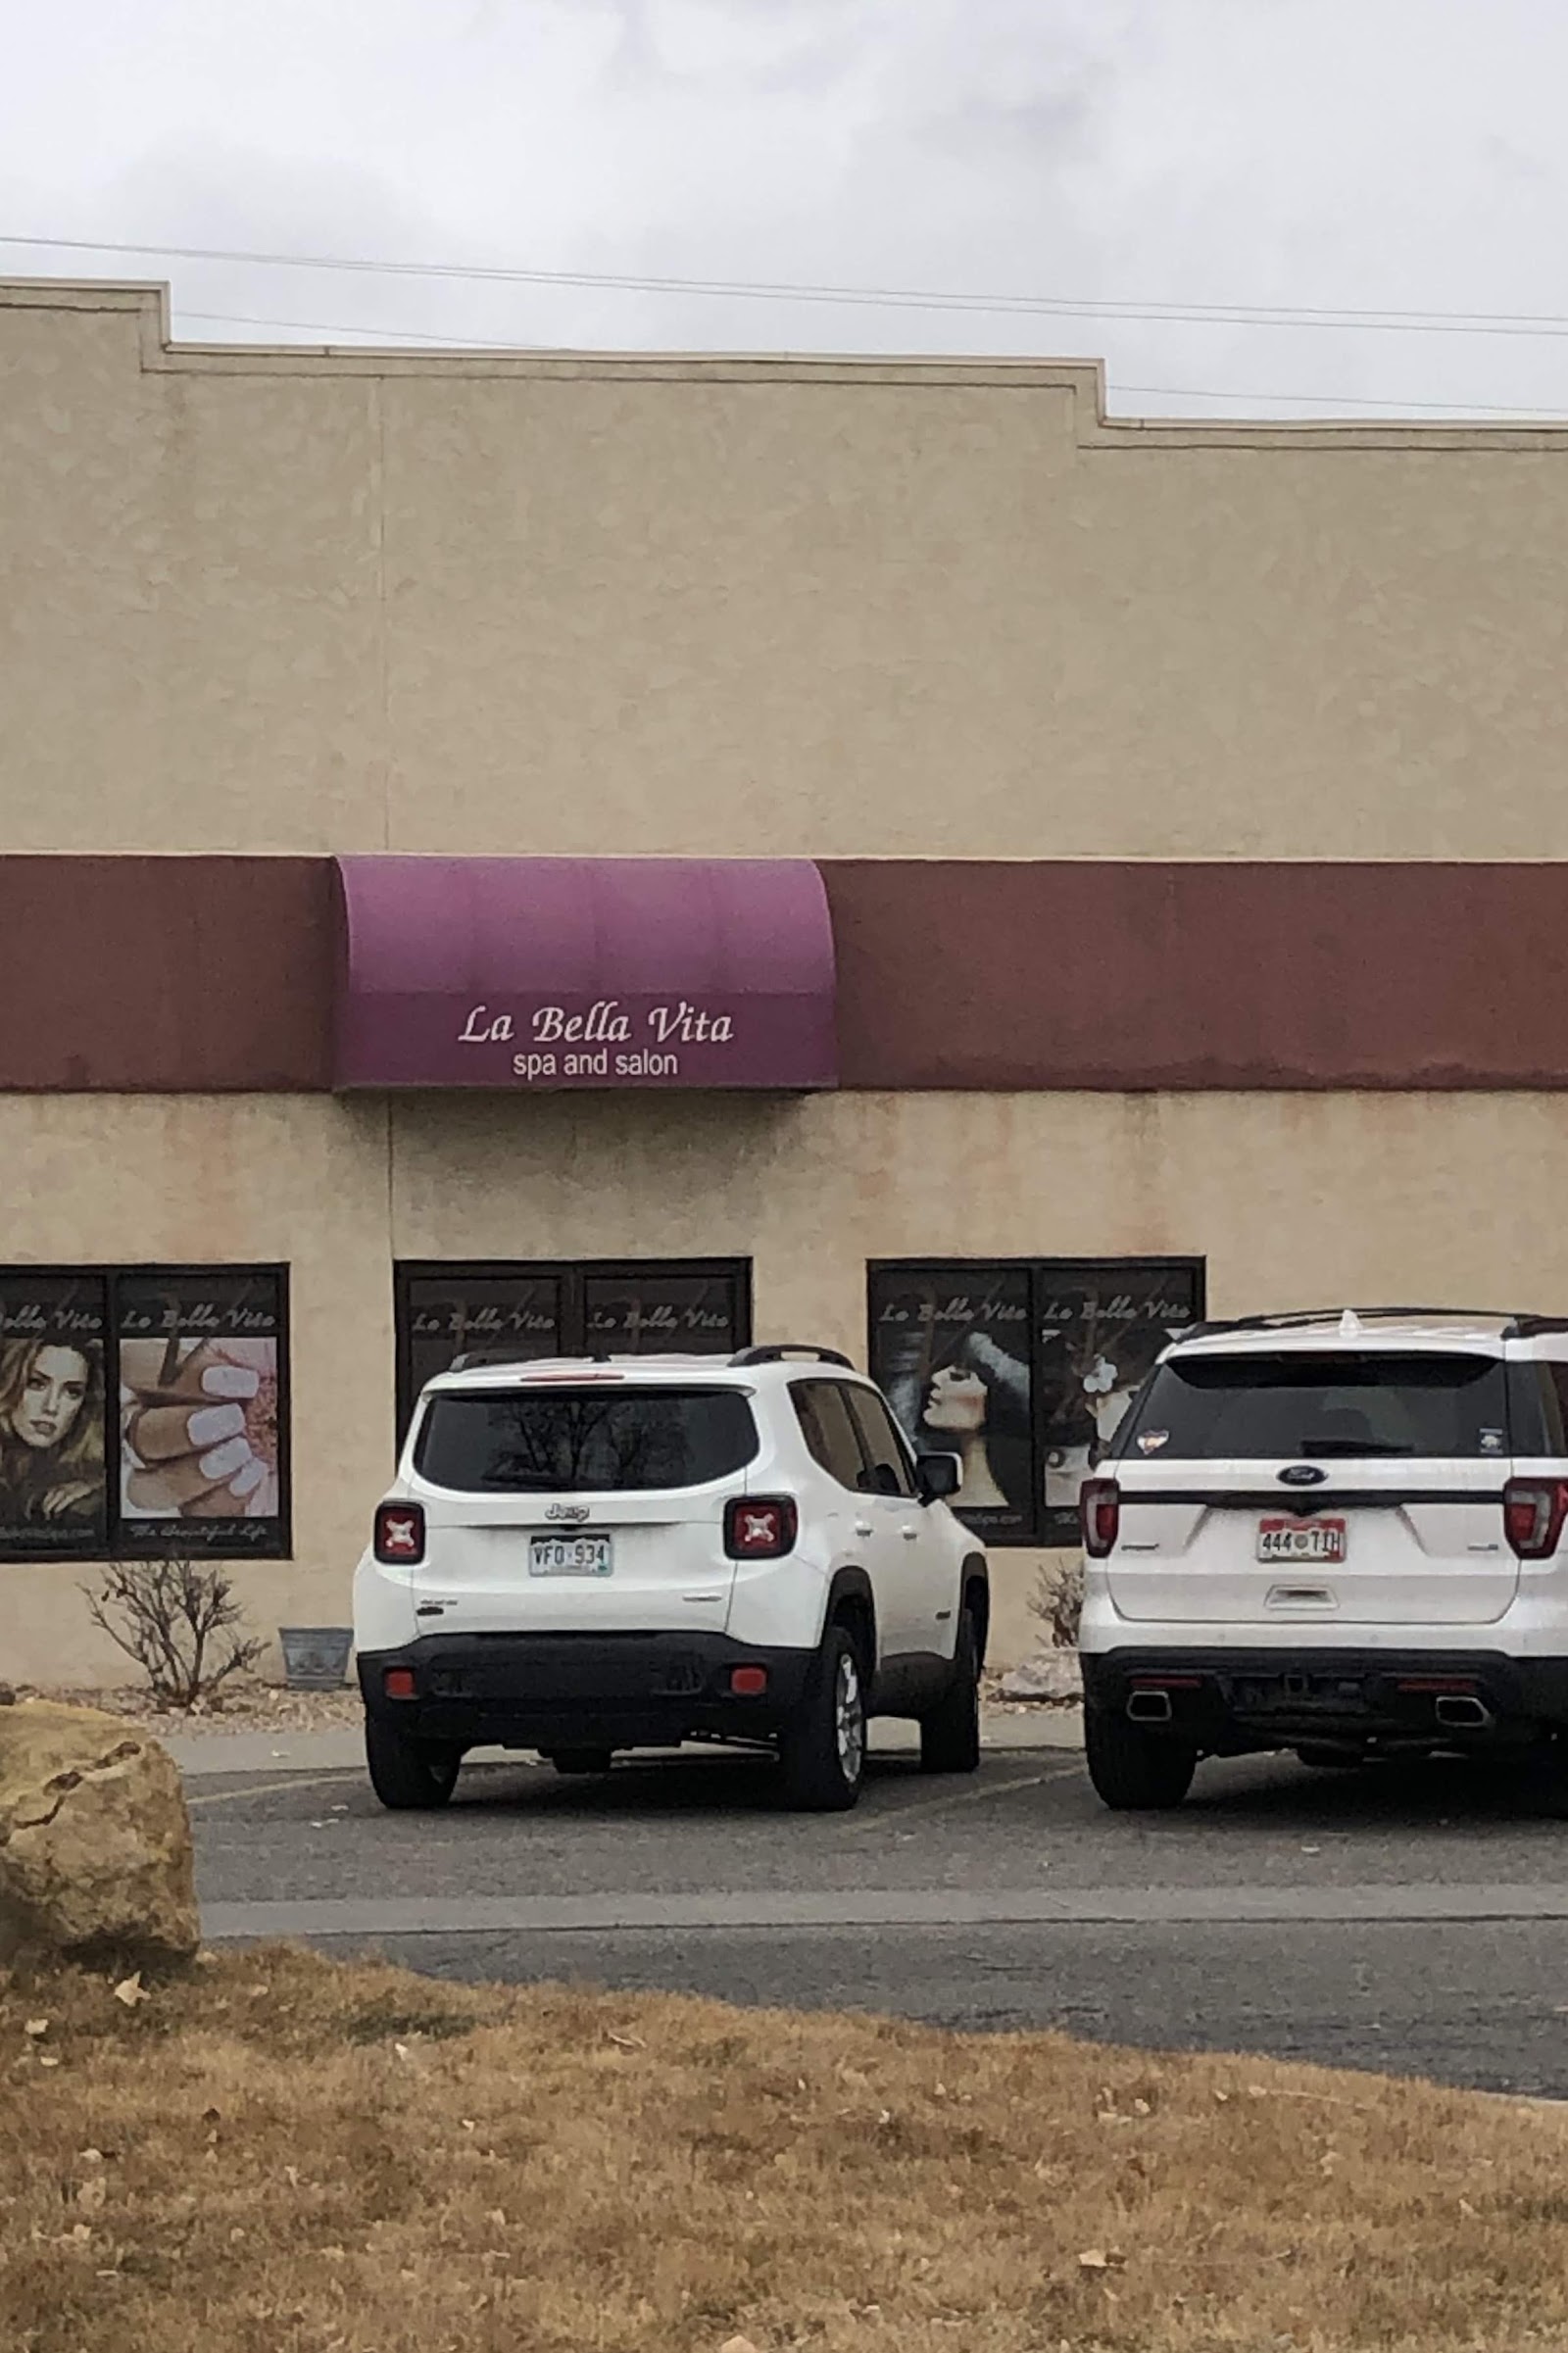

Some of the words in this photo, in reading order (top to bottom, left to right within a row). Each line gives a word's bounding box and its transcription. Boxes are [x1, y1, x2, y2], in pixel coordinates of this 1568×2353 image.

[458, 1005, 514, 1042] La
[532, 1001, 632, 1042] Bella
[648, 1001, 734, 1042] Vita
[513, 1052, 558, 1081] spa
[564, 1048, 608, 1075] and
[615, 1048, 678, 1075] salon
